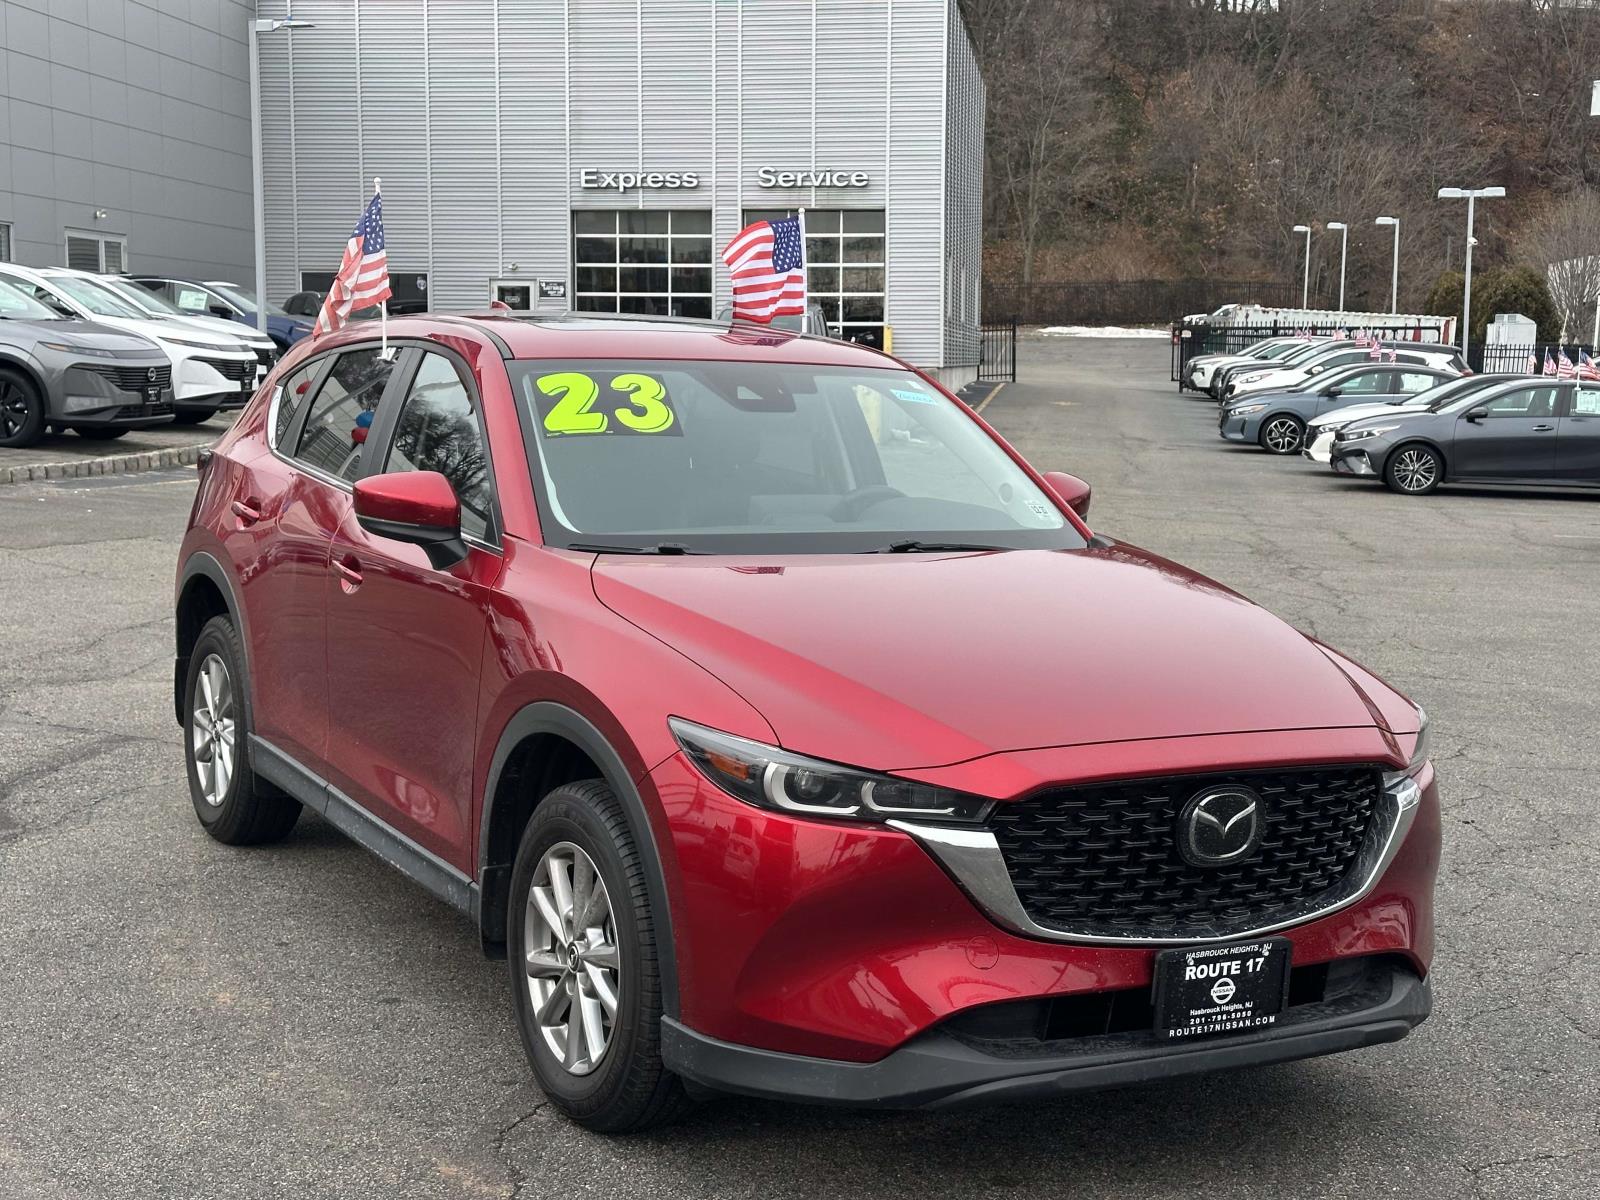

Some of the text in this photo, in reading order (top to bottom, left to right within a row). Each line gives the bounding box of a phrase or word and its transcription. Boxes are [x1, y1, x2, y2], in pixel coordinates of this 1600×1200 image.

[580, 166, 870, 193] Express Service
[536, 372, 674, 434] 23
[1185, 948, 1229, 959] HASBROUCK
[1263, 942, 1273, 950] NJ
[1185, 957, 1265, 981] ROUTE 17
[1212, 987, 1234, 995] NISSAN
[1189, 1006, 1221, 1016] Hasbrouck
[1221, 1002, 1244, 1013] Heights,
[1169, 1015, 1276, 1037] ROUTE17NISSAN.COM
